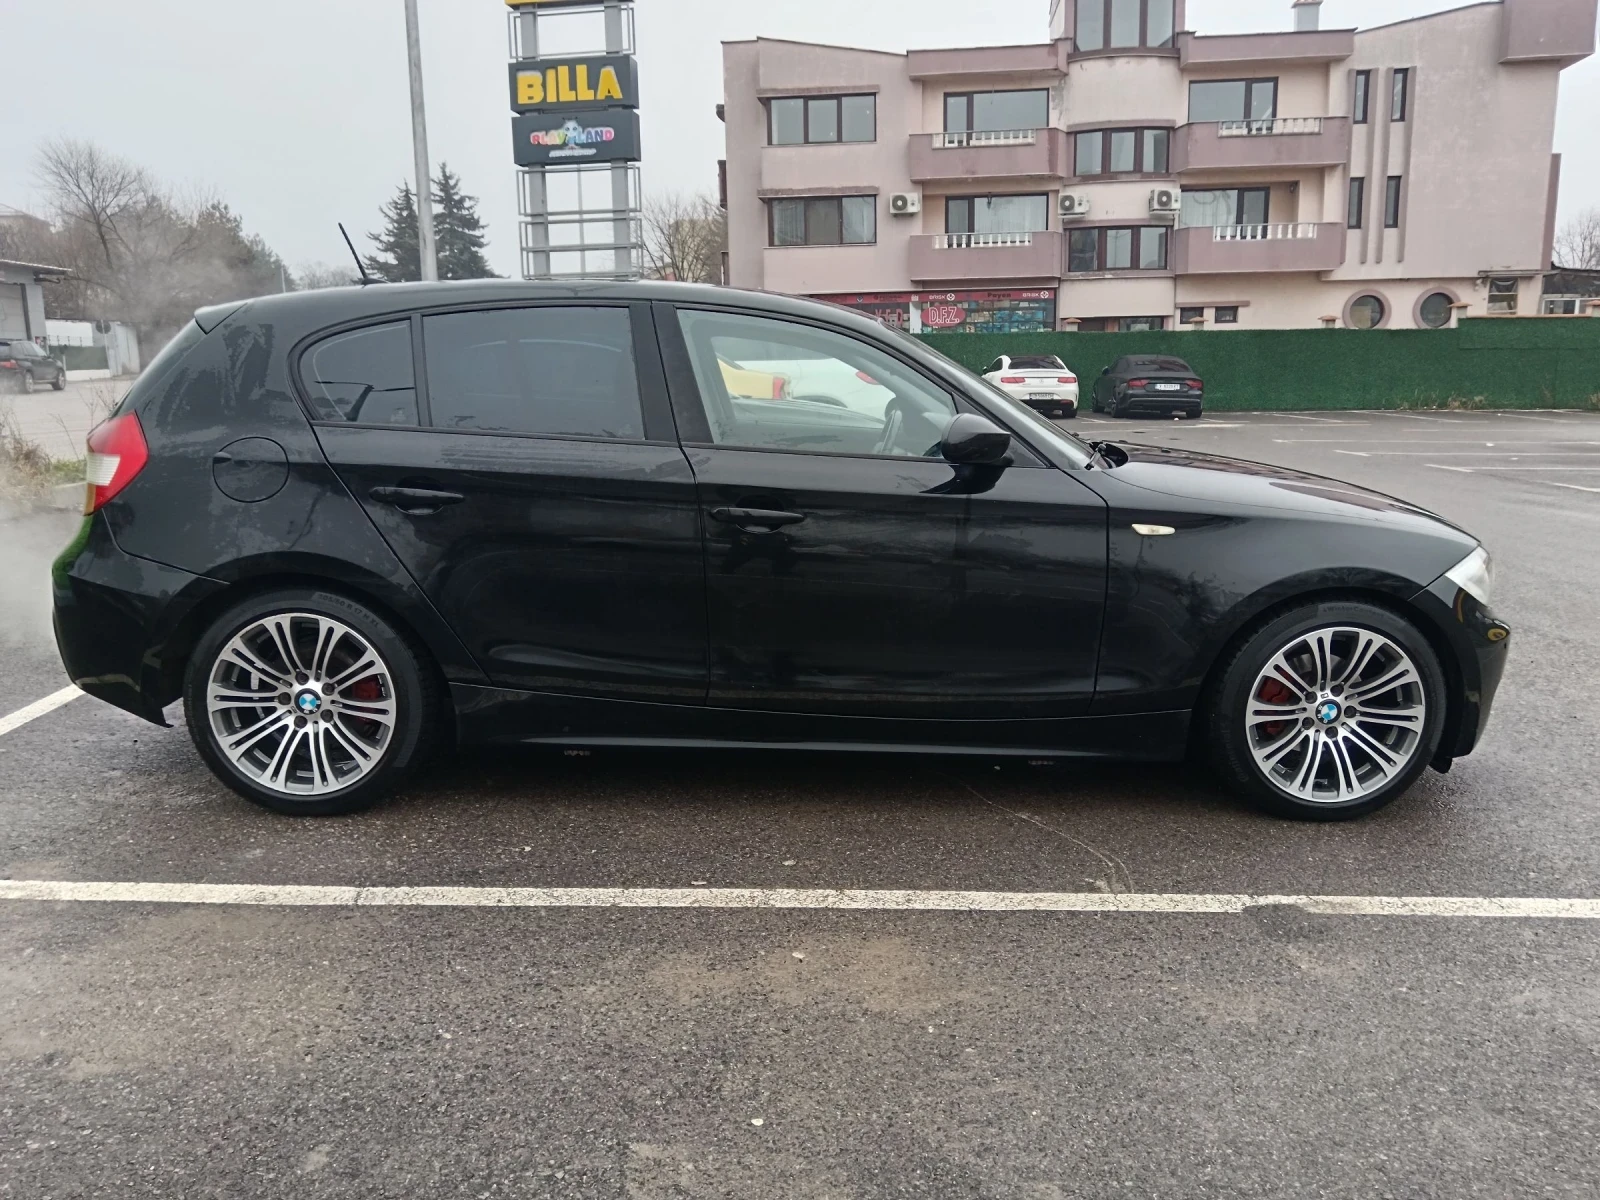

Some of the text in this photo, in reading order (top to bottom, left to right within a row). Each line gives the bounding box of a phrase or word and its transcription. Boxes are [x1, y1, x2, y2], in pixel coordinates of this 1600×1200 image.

[516, 64, 623, 105] BILLA
[928, 306, 960, 324] D.F.Z.
[354, 607, 363, 615] 17
